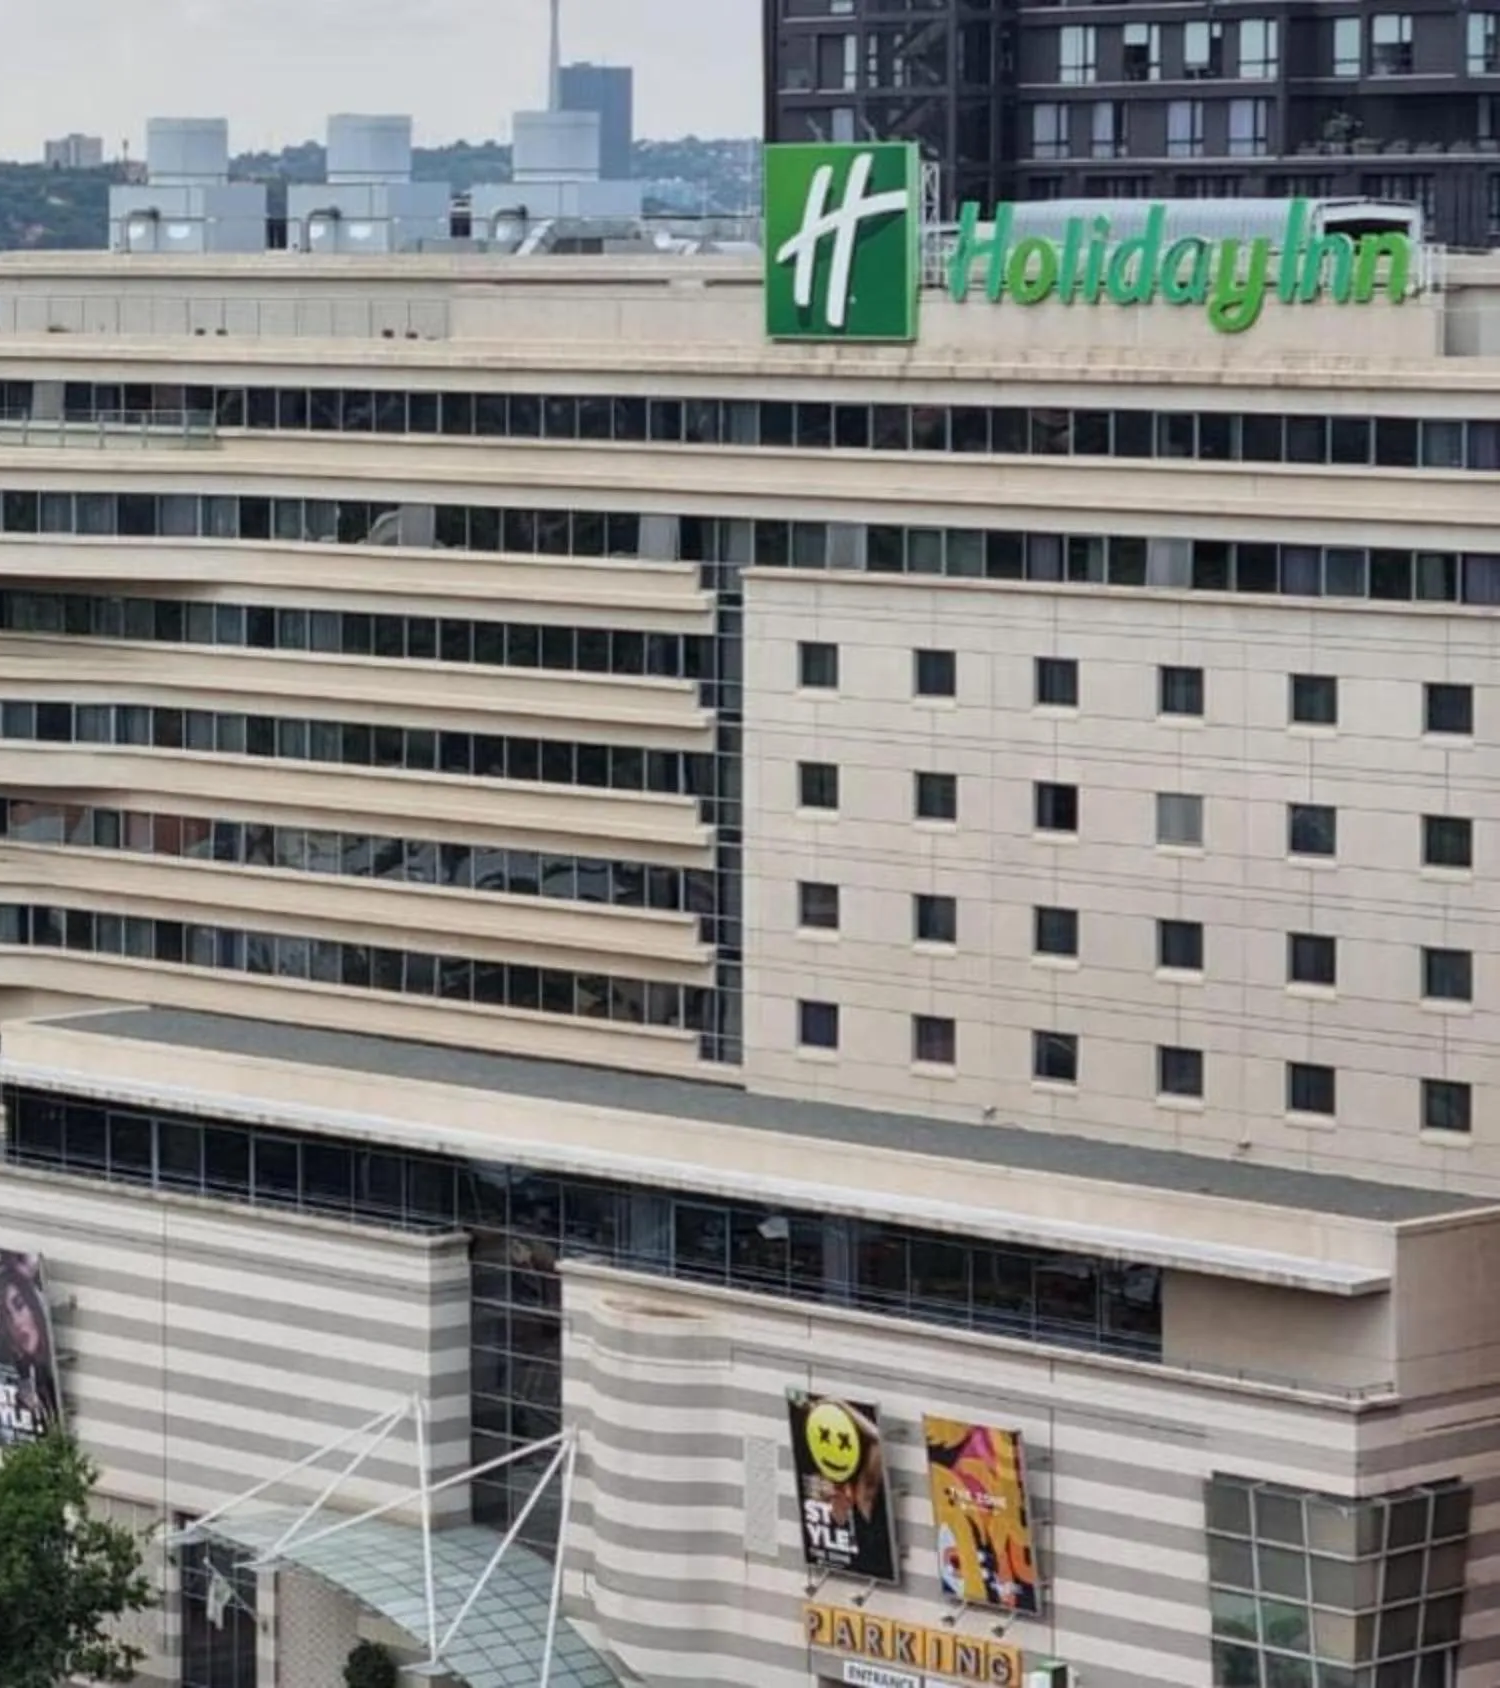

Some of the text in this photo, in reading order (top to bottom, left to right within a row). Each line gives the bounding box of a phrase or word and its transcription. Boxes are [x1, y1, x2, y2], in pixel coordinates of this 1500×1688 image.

[946, 196, 1413, 334] Holiday Inn
[804, 1499, 833, 1524] ST
[806, 1523, 859, 1553] YLE.
[805, 1611, 1013, 1687] PARKING
